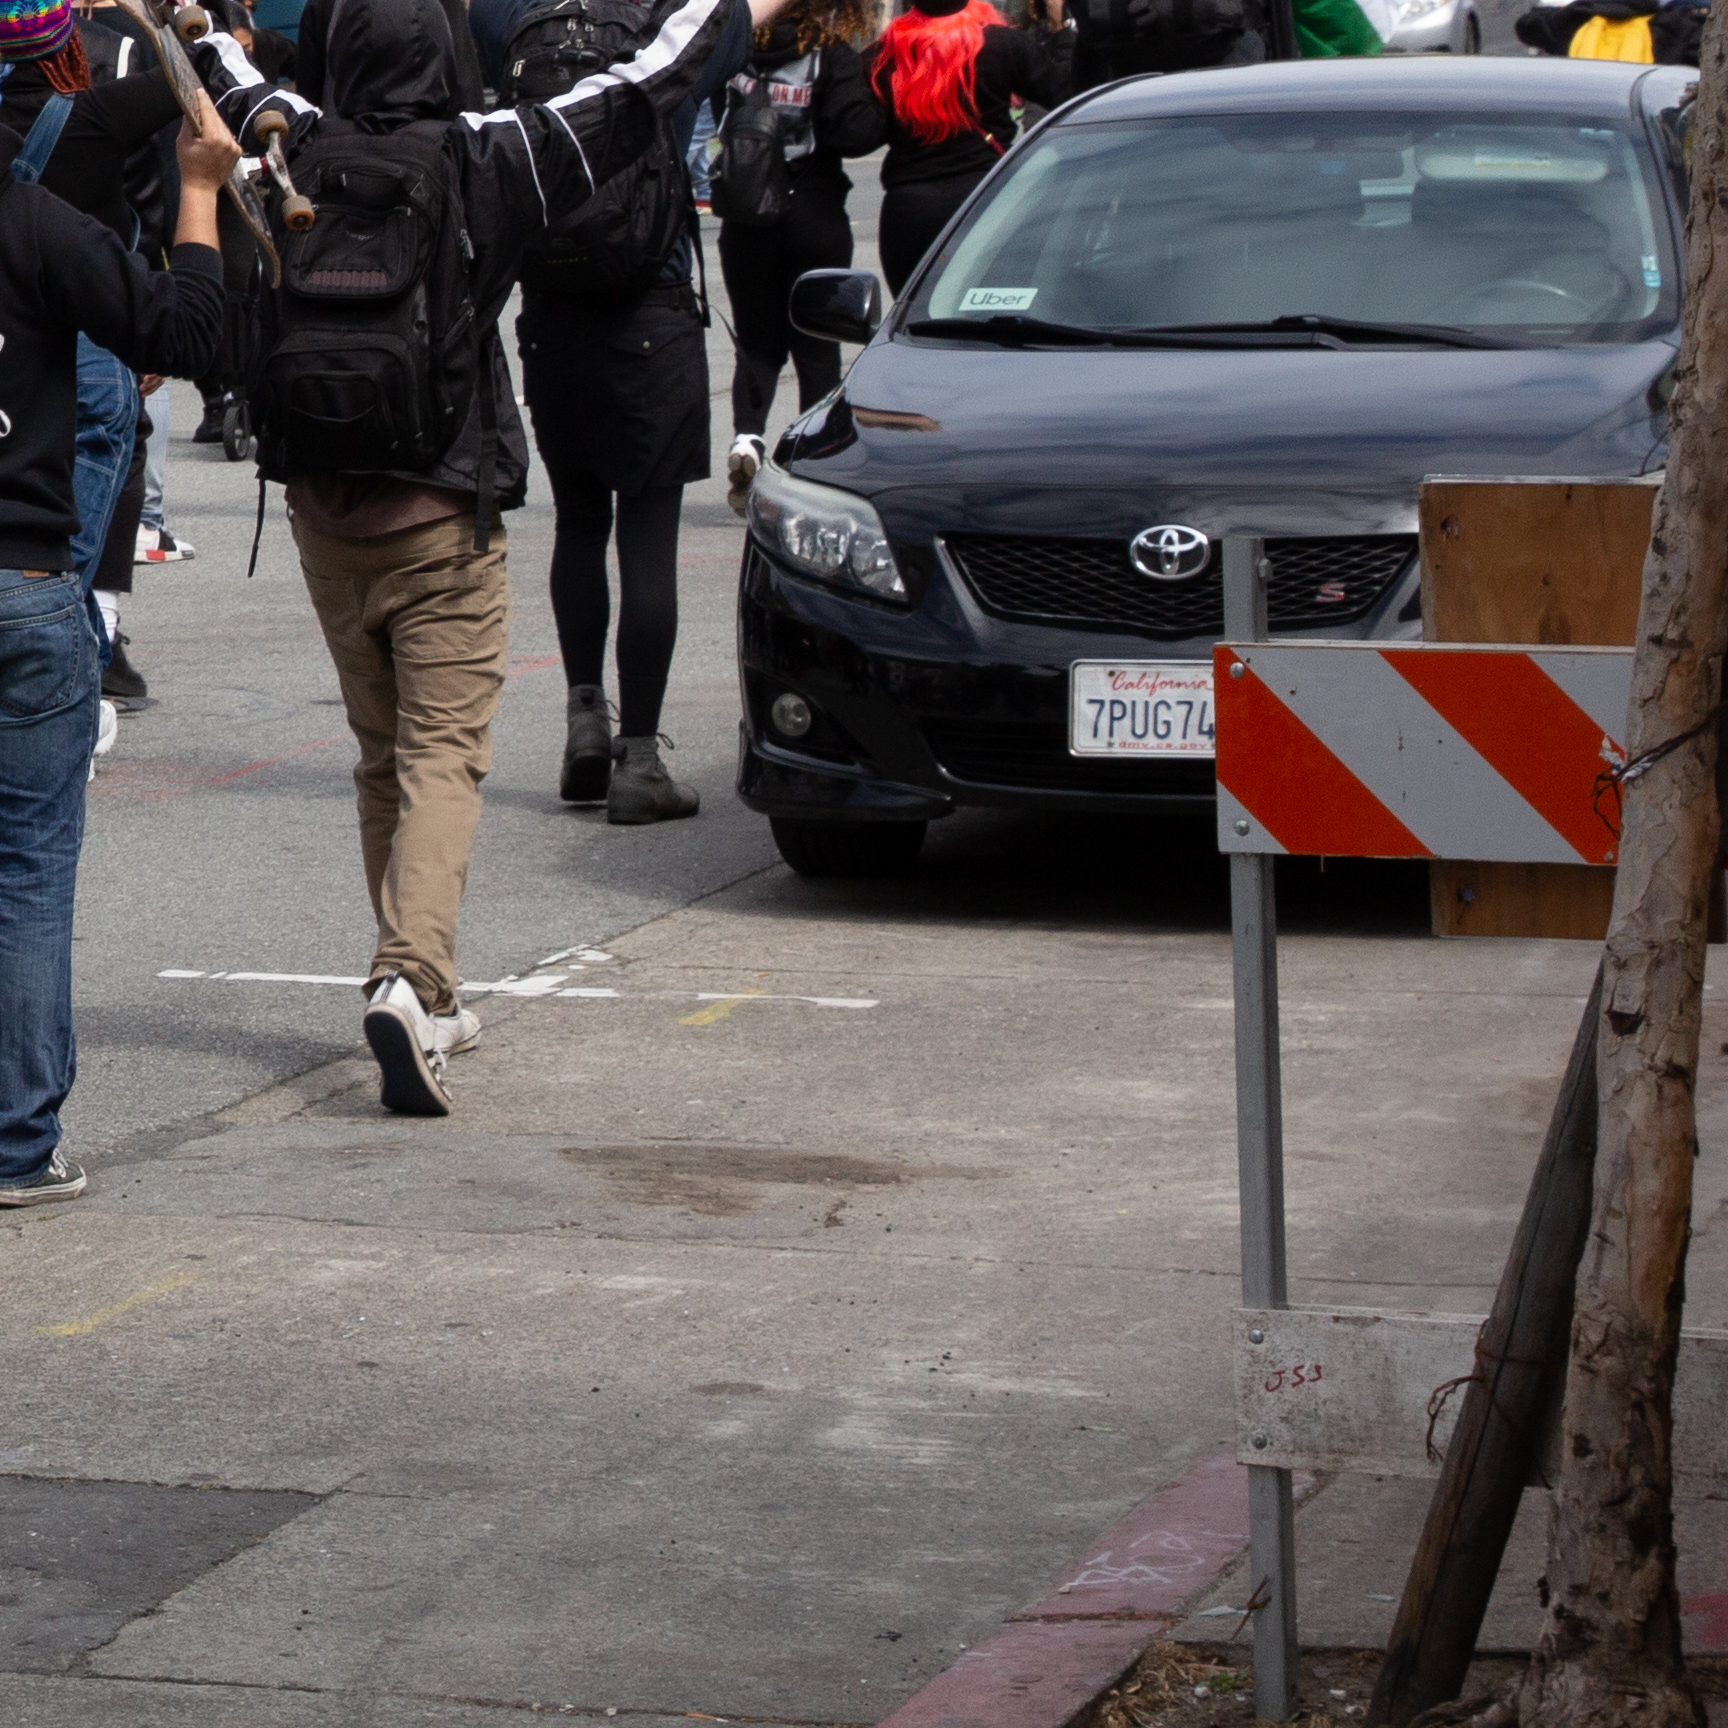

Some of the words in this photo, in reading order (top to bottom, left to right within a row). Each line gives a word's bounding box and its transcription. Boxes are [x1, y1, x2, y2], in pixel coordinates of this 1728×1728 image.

[969, 292, 1027, 306] Uber
[1111, 670, 1212, 697] California
[1118, 740, 1208, 750] dmv.ca.gov
